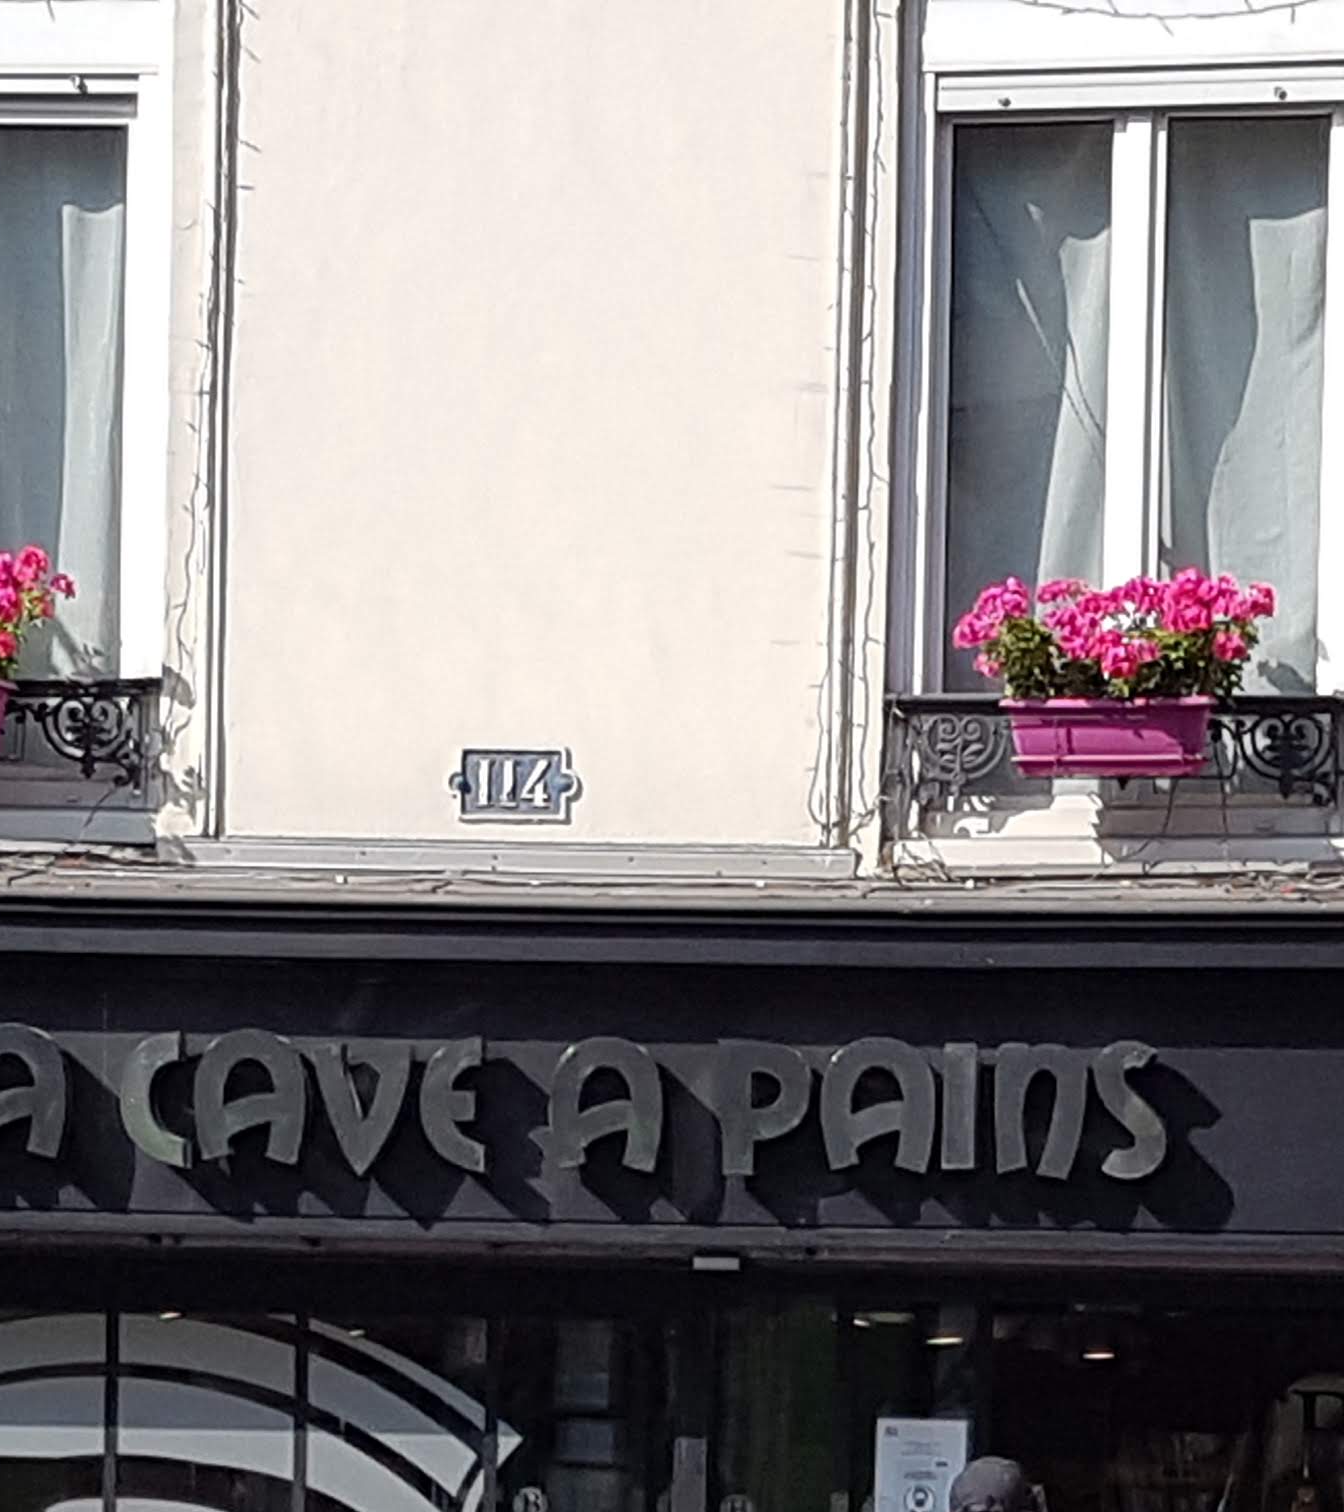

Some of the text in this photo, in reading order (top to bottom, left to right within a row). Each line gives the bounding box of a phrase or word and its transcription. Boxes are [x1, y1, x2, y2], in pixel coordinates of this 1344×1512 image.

[476, 758, 549, 808] 114
[118, 1028, 486, 1176] CAVE
[718, 1036, 1167, 1181] PAINS
